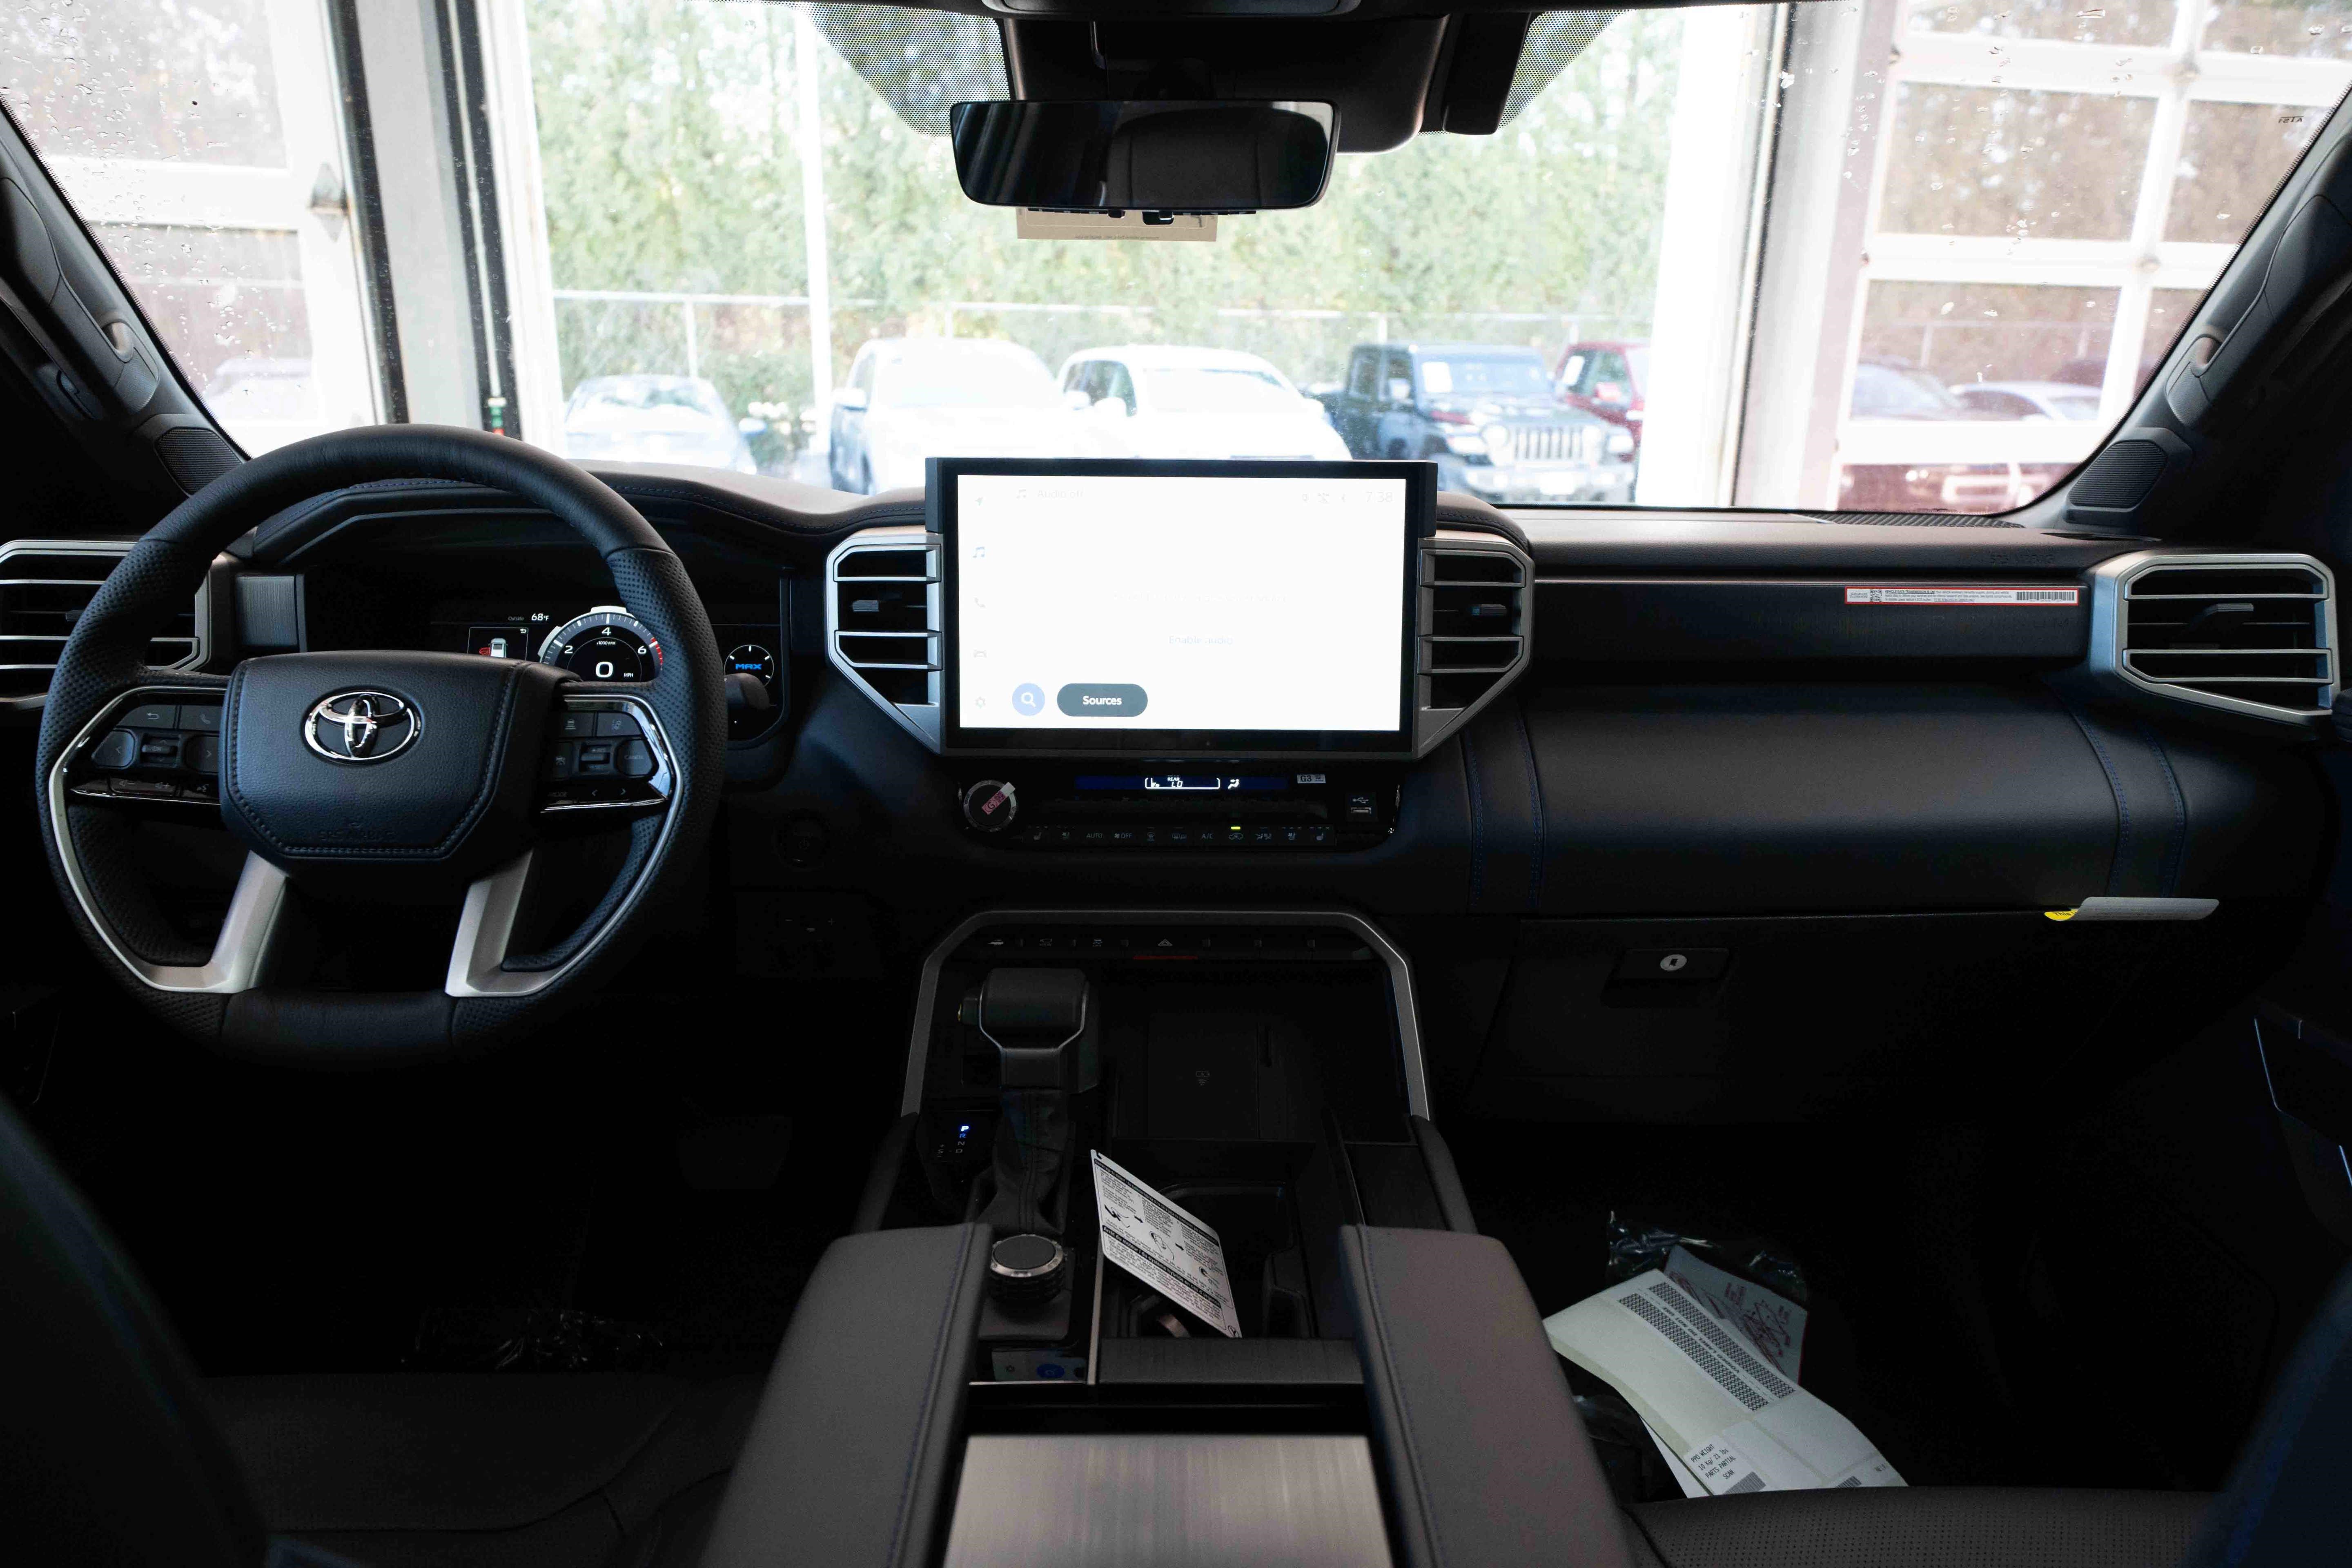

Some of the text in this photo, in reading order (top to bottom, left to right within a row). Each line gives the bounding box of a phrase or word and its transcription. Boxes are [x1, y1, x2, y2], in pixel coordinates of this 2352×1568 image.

[601, 627, 611, 635] 4
[1169, 635, 1202, 644] Enable
[564, 645, 573, 654] 2
[638, 646, 647, 655] 6
[595, 661, 614, 678] 0
[1083, 695, 1122, 706] Sources
[1123, 1238, 1138, 1252] moteur
[1167, 1268, 1183, 1282] hybride
[1700, 1443, 1715, 1456] WEIGHT
[1705, 1455, 1737, 1479] PARTS PARTIAL
[1723, 1469, 1735, 1480] SCAN
